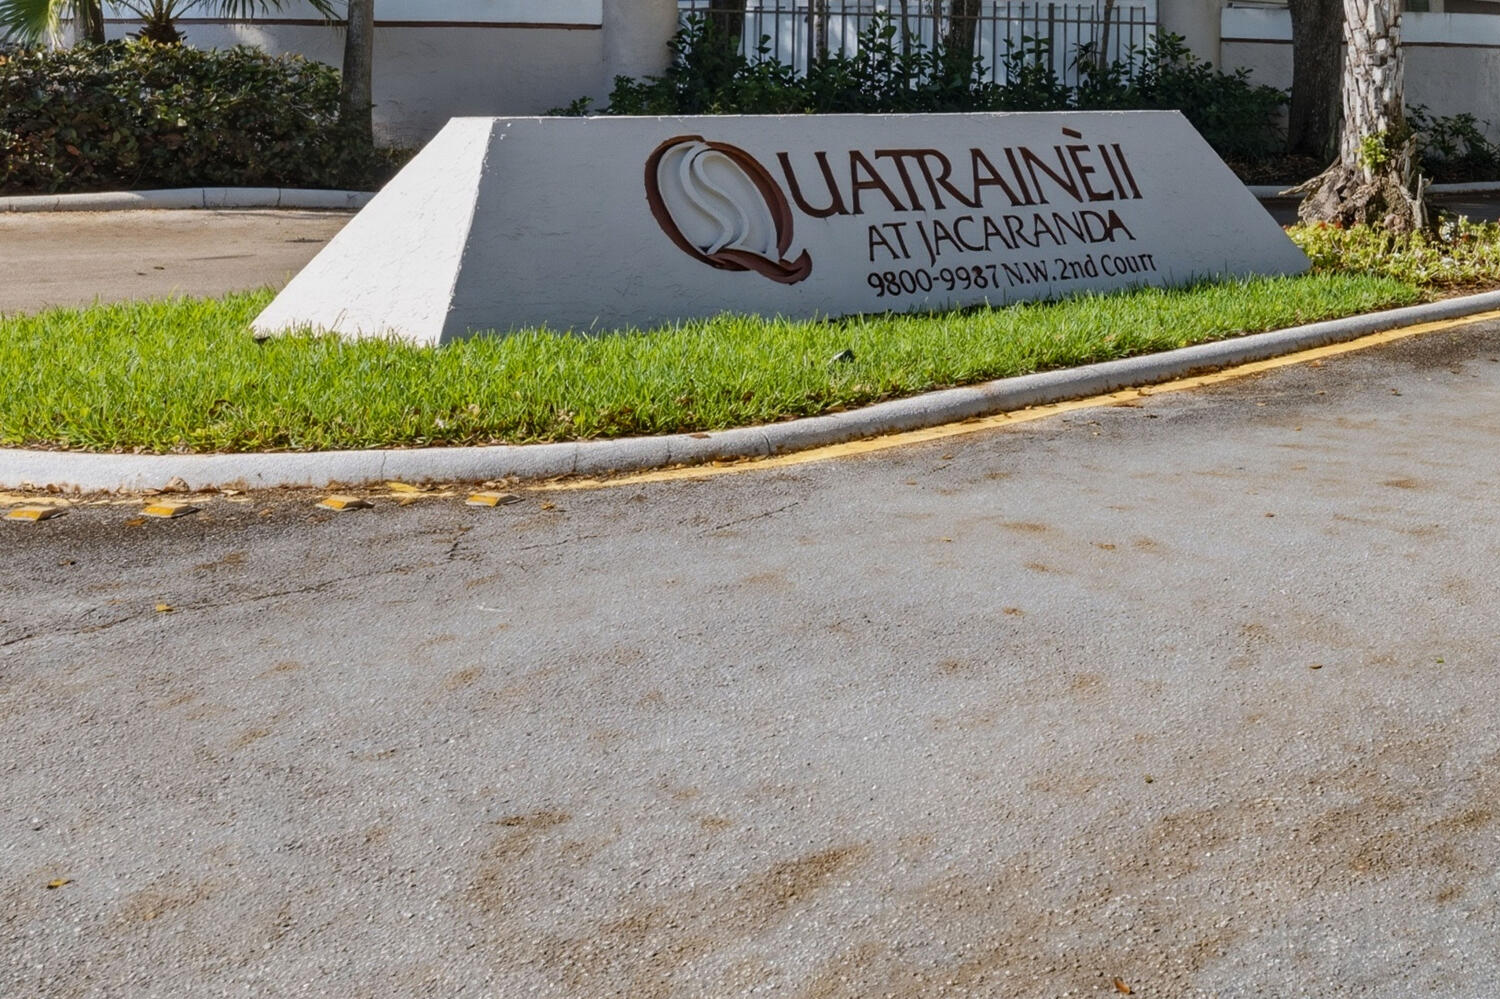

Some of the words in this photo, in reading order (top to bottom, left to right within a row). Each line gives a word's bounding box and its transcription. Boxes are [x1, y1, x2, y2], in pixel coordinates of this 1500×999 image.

[868, 222, 911, 262] AT
[916, 209, 1137, 268] JACARANDA
[867, 265, 1000, 297] 9800-9987
[1001, 260, 1057, 287] N.W.
[1054, 254, 1099, 281] 2nd
[1100, 253, 1157, 278] Court
